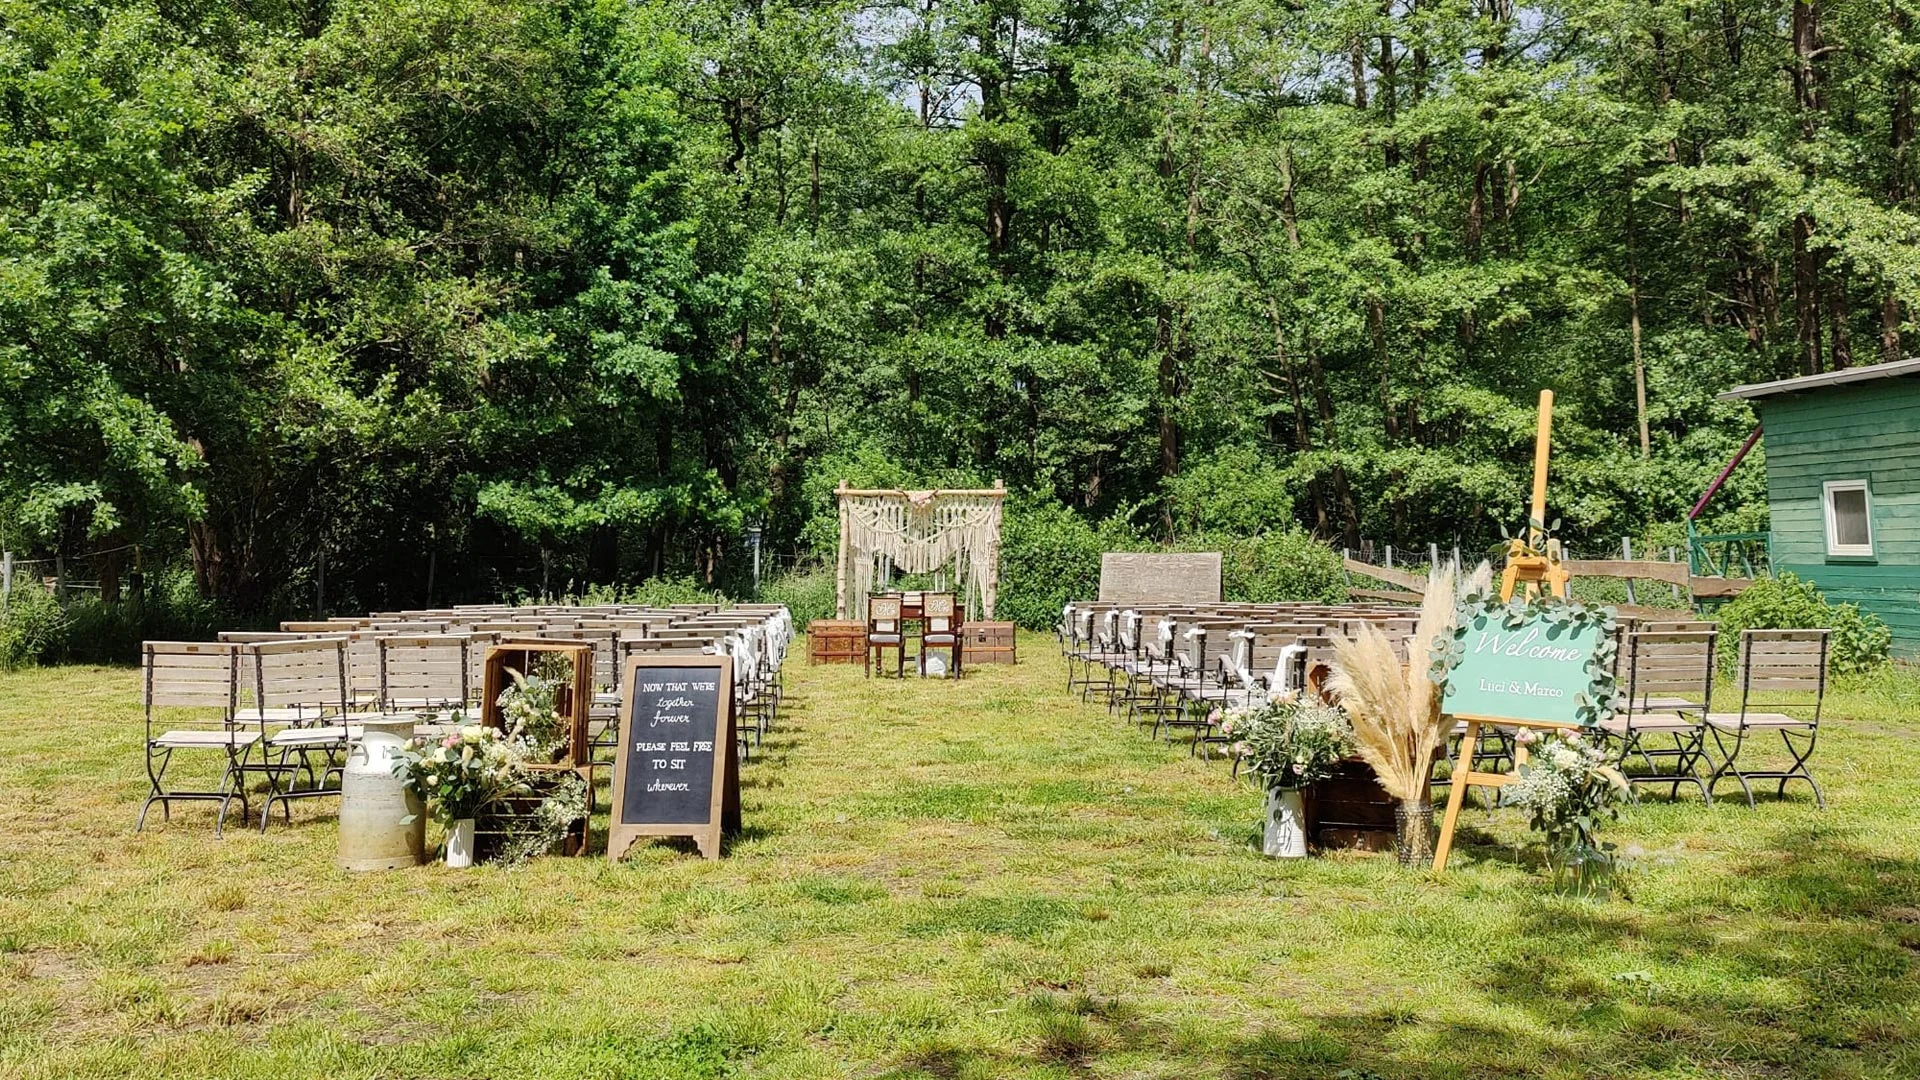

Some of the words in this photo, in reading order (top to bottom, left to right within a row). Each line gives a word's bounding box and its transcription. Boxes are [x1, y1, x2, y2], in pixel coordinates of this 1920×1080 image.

[1474, 627, 1582, 661] Welcome
[643, 683, 664, 692] NOW
[666, 683, 688, 692] THAT
[1480, 678, 1505, 692] Luci
[1508, 680, 1521, 694] &
[1523, 681, 1564, 697] Marco
[656, 697, 694, 710] together
[650, 710, 690, 728] forever
[636, 742, 667, 752] PLEASE
[670, 742, 690, 751] FEEL
[693, 741, 713, 752] FREE
[652, 759, 667, 770] TO
[670, 759, 686, 769] SIT
[647, 778, 690, 792] wherever
